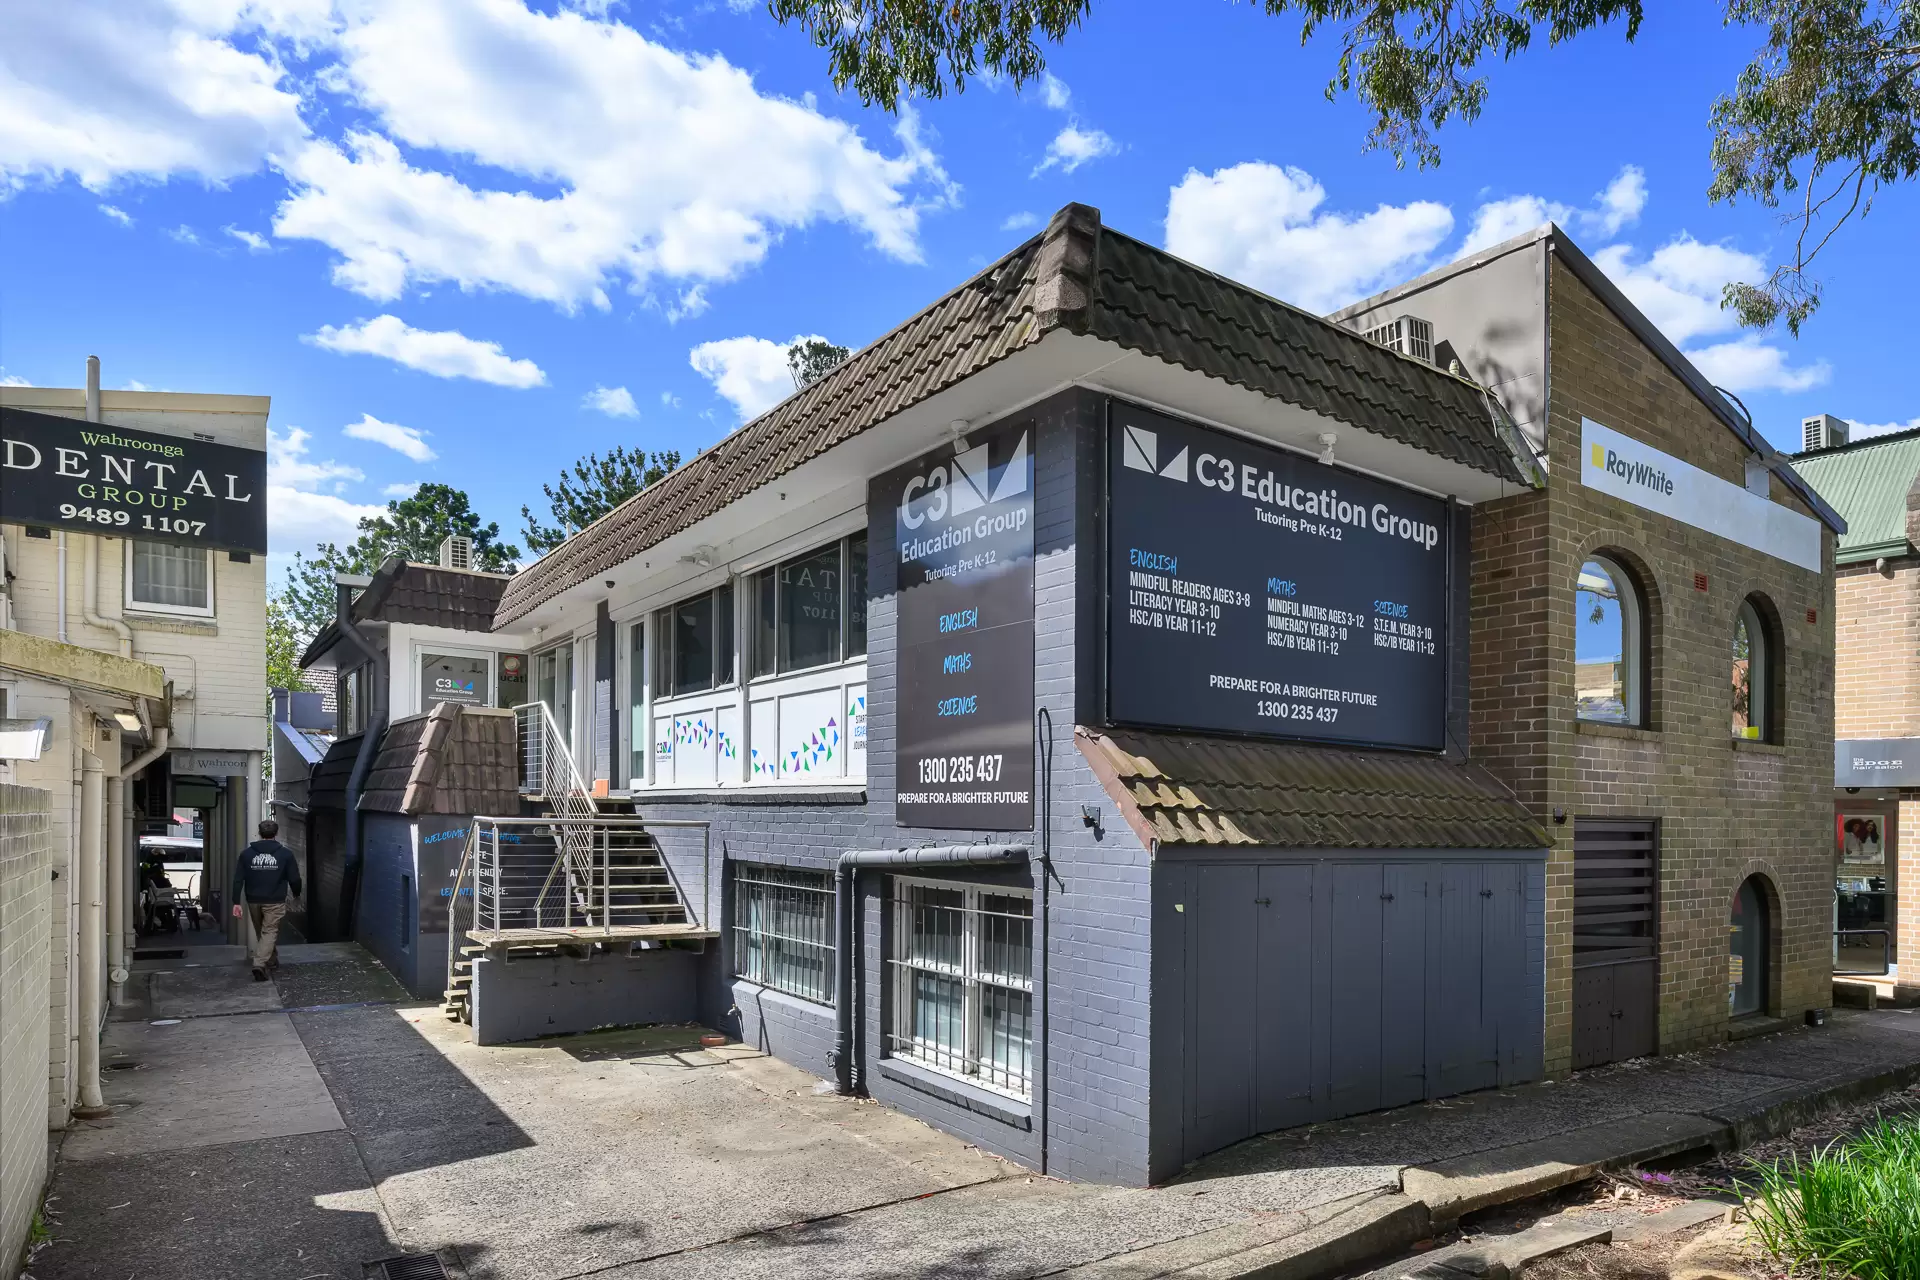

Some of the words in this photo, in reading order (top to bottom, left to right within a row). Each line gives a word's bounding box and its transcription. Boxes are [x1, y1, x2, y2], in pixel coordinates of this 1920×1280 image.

[80, 431, 184, 457] Wahroonga
[3, 439, 251, 503] DENTAL
[1606, 450, 1674, 496] RayWhite
[78, 483, 188, 511] GROUP
[902, 466, 948, 530] C3
[1196, 453, 1235, 492] C3
[1242, 464, 1366, 528] Education
[1371, 504, 1438, 550] Group
[59, 504, 130, 526] 9489
[142, 514, 206, 536] 1107
[1255, 507, 1298, 532] Tutoring
[1300, 519, 1316, 535] Pre
[1318, 524, 1342, 541] K-12
[902, 526, 972, 564] Education
[974, 507, 1027, 539] Group
[924, 564, 956, 582] Tutoring
[958, 558, 972, 573] Pre
[974, 551, 996, 568] K-12
[1130, 548, 1178, 576] ENGLISH
[1130, 571, 1170, 593] MINDFUL
[1172, 579, 1211, 600] READERS
[1213, 588, 1234, 604] AGES
[1236, 592, 1250, 608] 3-8
[1268, 577, 1296, 598] MATHS
[1130, 590, 1172, 611] LITERACY
[1174, 598, 1198, 616] YEAR
[1200, 602, 1220, 619] 3-10
[1268, 598, 1300, 617] MINDFUL
[1302, 604, 1327, 622] MATHS
[1328, 609, 1346, 624] AGES
[1348, 612, 1364, 628] 3-12
[1374, 600, 1408, 618] SCIENCE
[940, 607, 978, 633] ENGLISH
[1130, 608, 1162, 628] HSC/IB
[1164, 614, 1188, 632] YEAR
[1191, 618, 1216, 636] 11-12
[1268, 614, 1308, 634] NUMERACY
[1310, 622, 1328, 638] YEAR
[1330, 626, 1348, 640] 3-10
[1374, 618, 1398, 634] S.T.E.M.
[1400, 622, 1416, 638] YEAR
[1417, 626, 1432, 640] 3-10
[1268, 632, 1294, 649] HSC/IB
[1296, 636, 1316, 652] YEAR
[1318, 640, 1339, 656] 11-12
[1374, 633, 1398, 648] HSC/IB
[1399, 636, 1414, 652] YEAR
[1417, 640, 1434, 655] 11-12
[944, 652, 972, 674] MATHS
[436, 678, 452, 688] C3
[1210, 674, 1258, 692] PREPARE
[1260, 681, 1281, 696] FOR
[1282, 684, 1290, 696] A
[1292, 684, 1340, 702] BRIGHTER
[1342, 691, 1378, 706] FUTURE
[938, 695, 978, 716] SCIENCE
[1257, 700, 1288, 718] 1300
[1291, 704, 1313, 720] 235
[1316, 708, 1338, 723] 437
[198, 759, 247, 768] Wahroon
[918, 758, 947, 784] 1300
[950, 756, 974, 783] 235
[976, 755, 1002, 782] 437
[898, 792, 929, 804] PREPARE
[930, 793, 946, 804] FOR
[945, 793, 951, 804] A
[952, 792, 992, 804] BRIGHTER
[994, 792, 1028, 804] FUTURE
[424, 828, 464, 844] WELCOME
